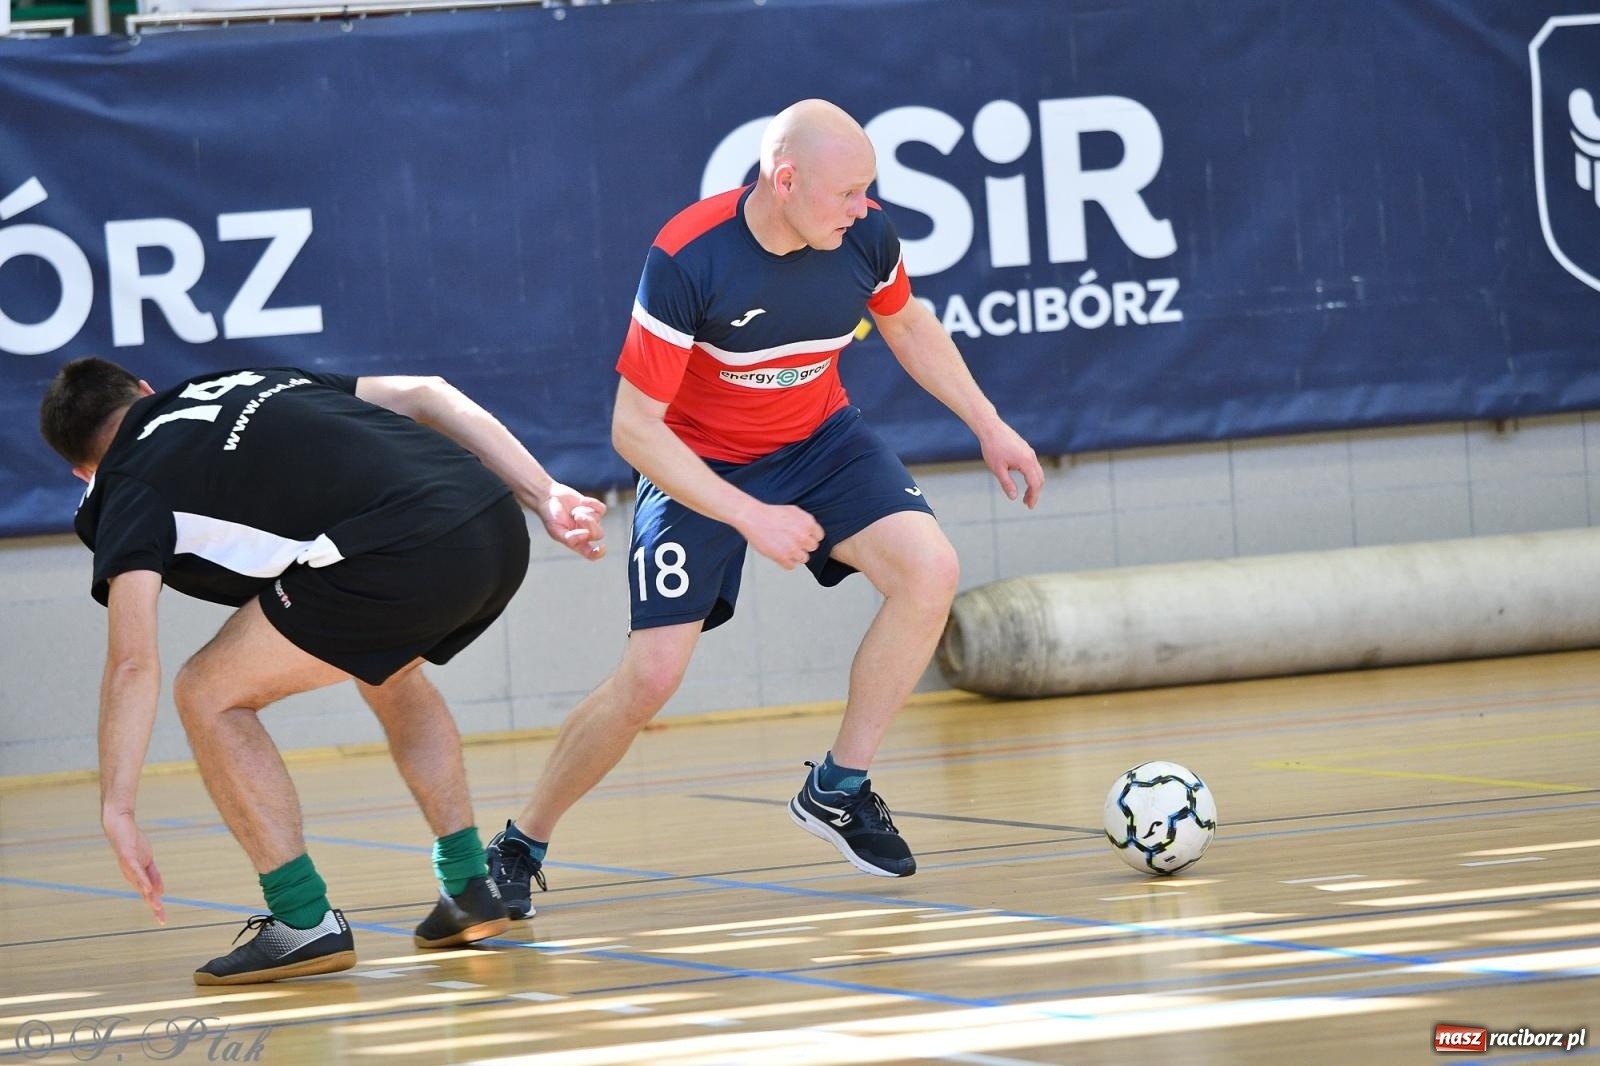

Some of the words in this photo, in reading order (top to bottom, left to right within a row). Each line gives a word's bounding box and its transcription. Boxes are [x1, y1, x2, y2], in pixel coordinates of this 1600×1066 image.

[0, 176, 323, 355] ÓRZ
[916, 268, 1184, 339] ACIBÓRZ
[137, 371, 266, 440] 14
[721, 370, 775, 384] energy
[633, 541, 690, 602] 18
